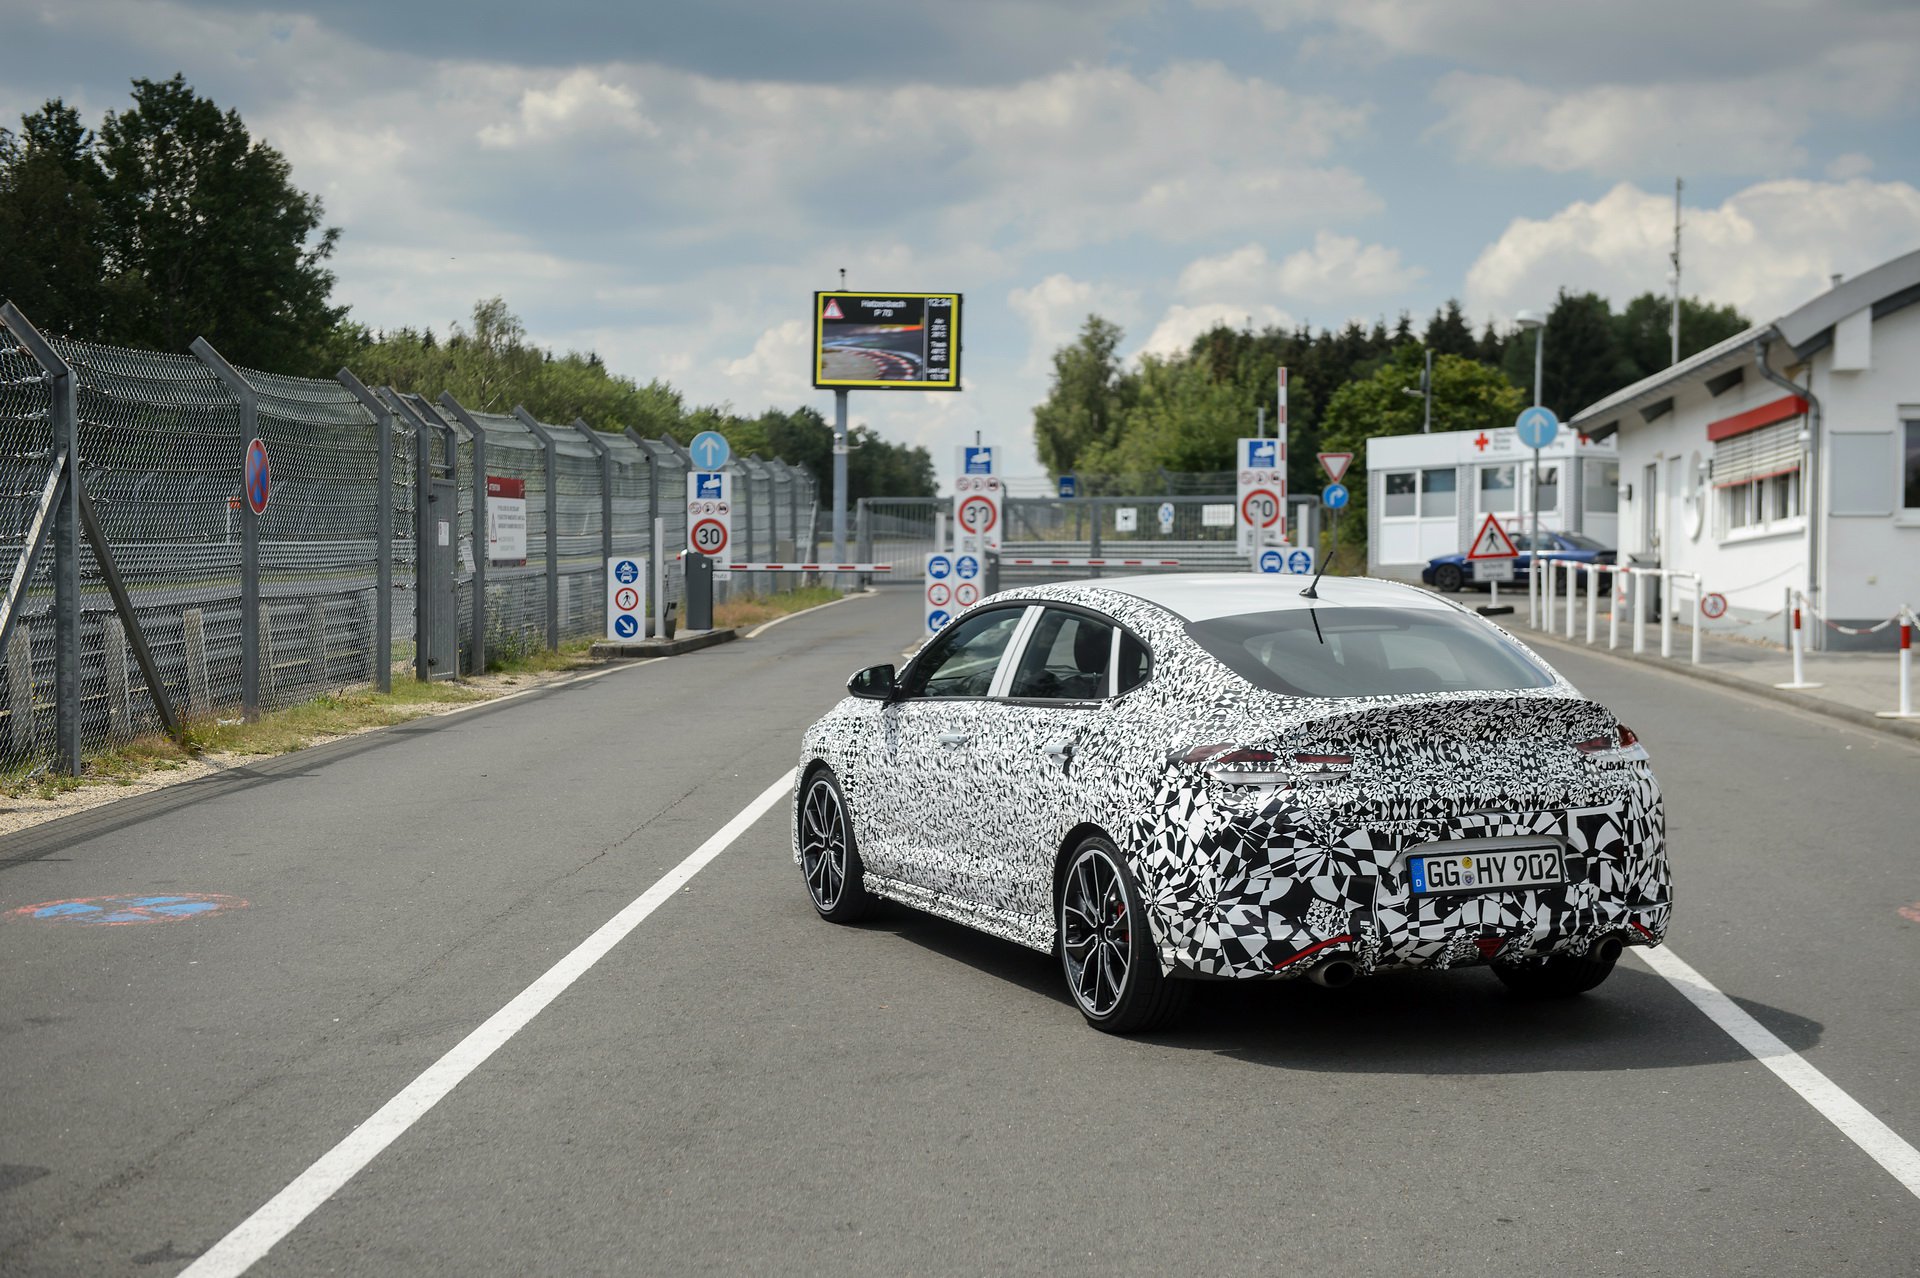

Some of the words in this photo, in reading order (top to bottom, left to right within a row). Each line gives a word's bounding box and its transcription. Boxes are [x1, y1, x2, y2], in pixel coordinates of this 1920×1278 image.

[698, 528, 720, 545] 30
[1427, 860, 1460, 888] GG
[1476, 856, 1506, 884] HY
[1513, 852, 1559, 881] 902
[1415, 879, 1422, 887] D
